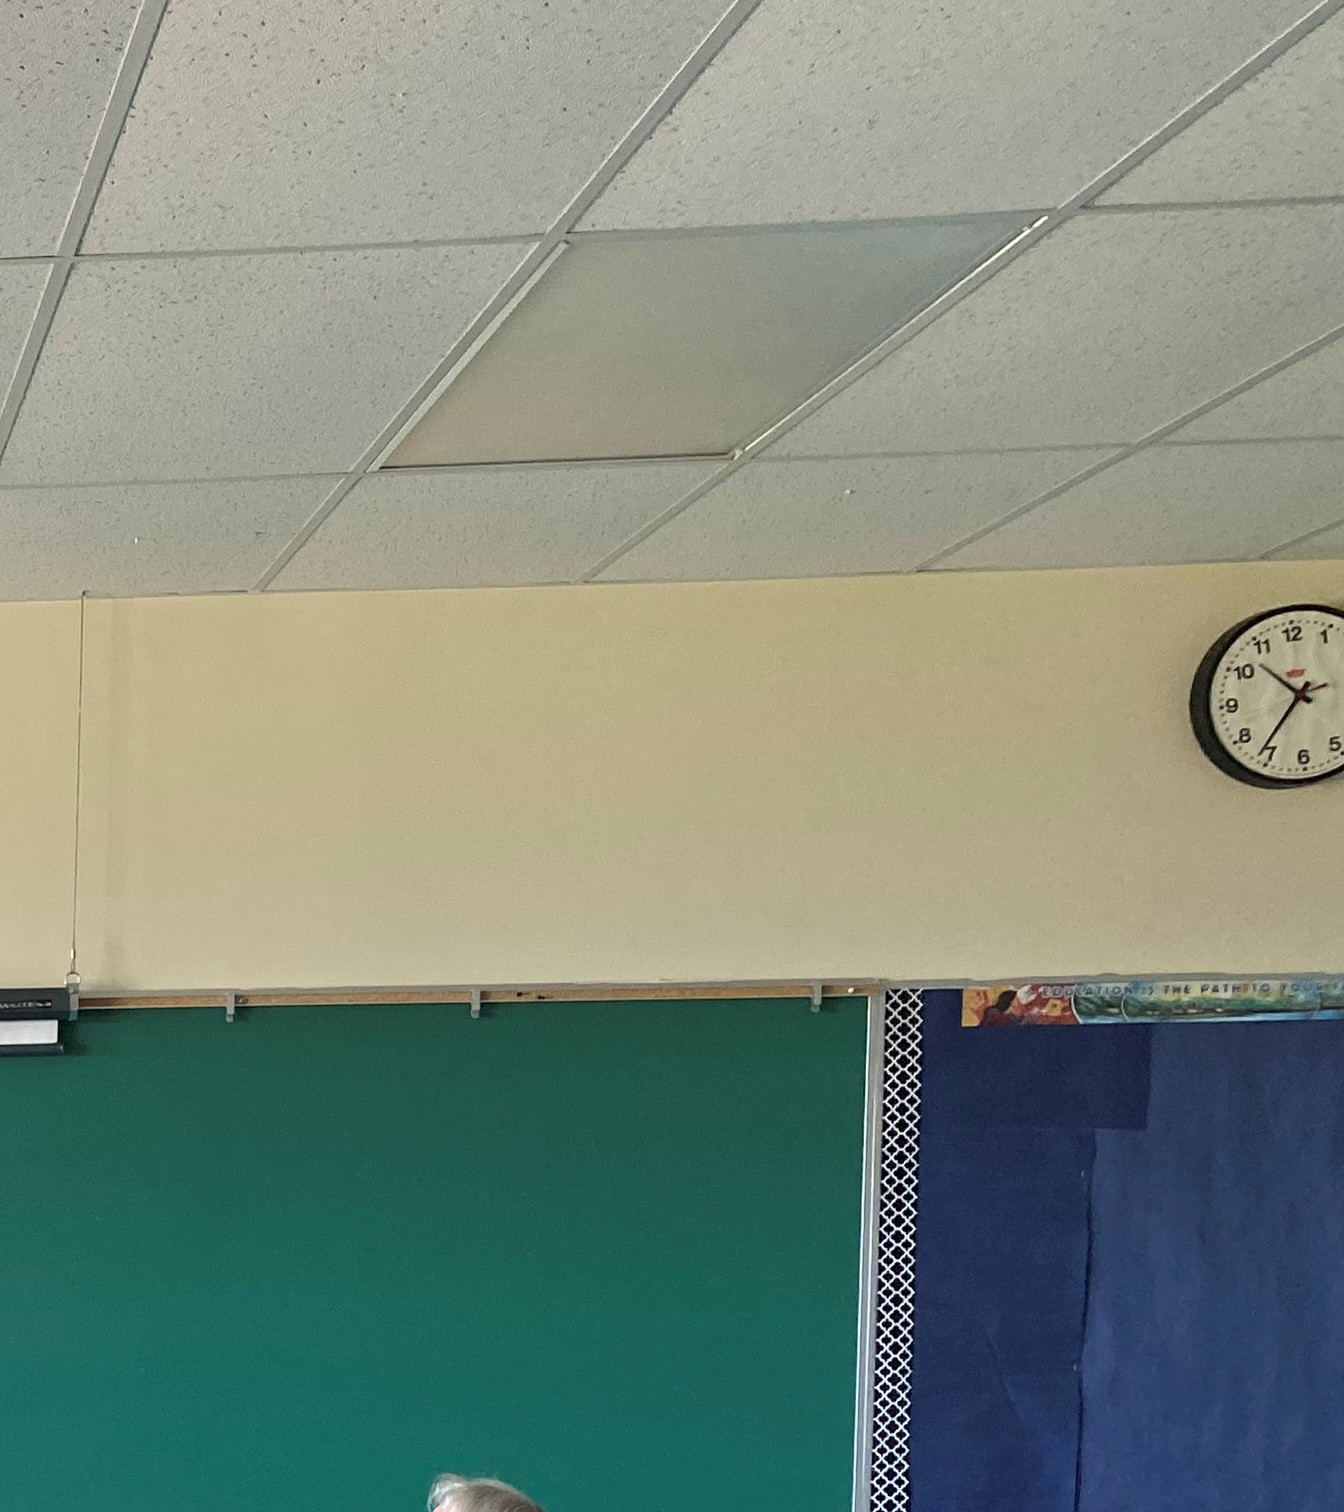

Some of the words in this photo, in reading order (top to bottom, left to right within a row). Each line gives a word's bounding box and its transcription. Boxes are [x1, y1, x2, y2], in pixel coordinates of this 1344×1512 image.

[1282, 626, 1303, 642] 12
[1320, 629, 1328, 644] 1
[1254, 639, 1270, 654] 11
[1234, 664, 1254, 680] 10
[1226, 698, 1238, 713] 9
[1239, 728, 1251, 743] 8
[1329, 736, 1341, 751] 5
[1263, 746, 1277, 761] 7
[1298, 750, 1310, 764] 6
[1163, 984, 1191, 994] THE
[1200, 984, 1240, 994] PATH
